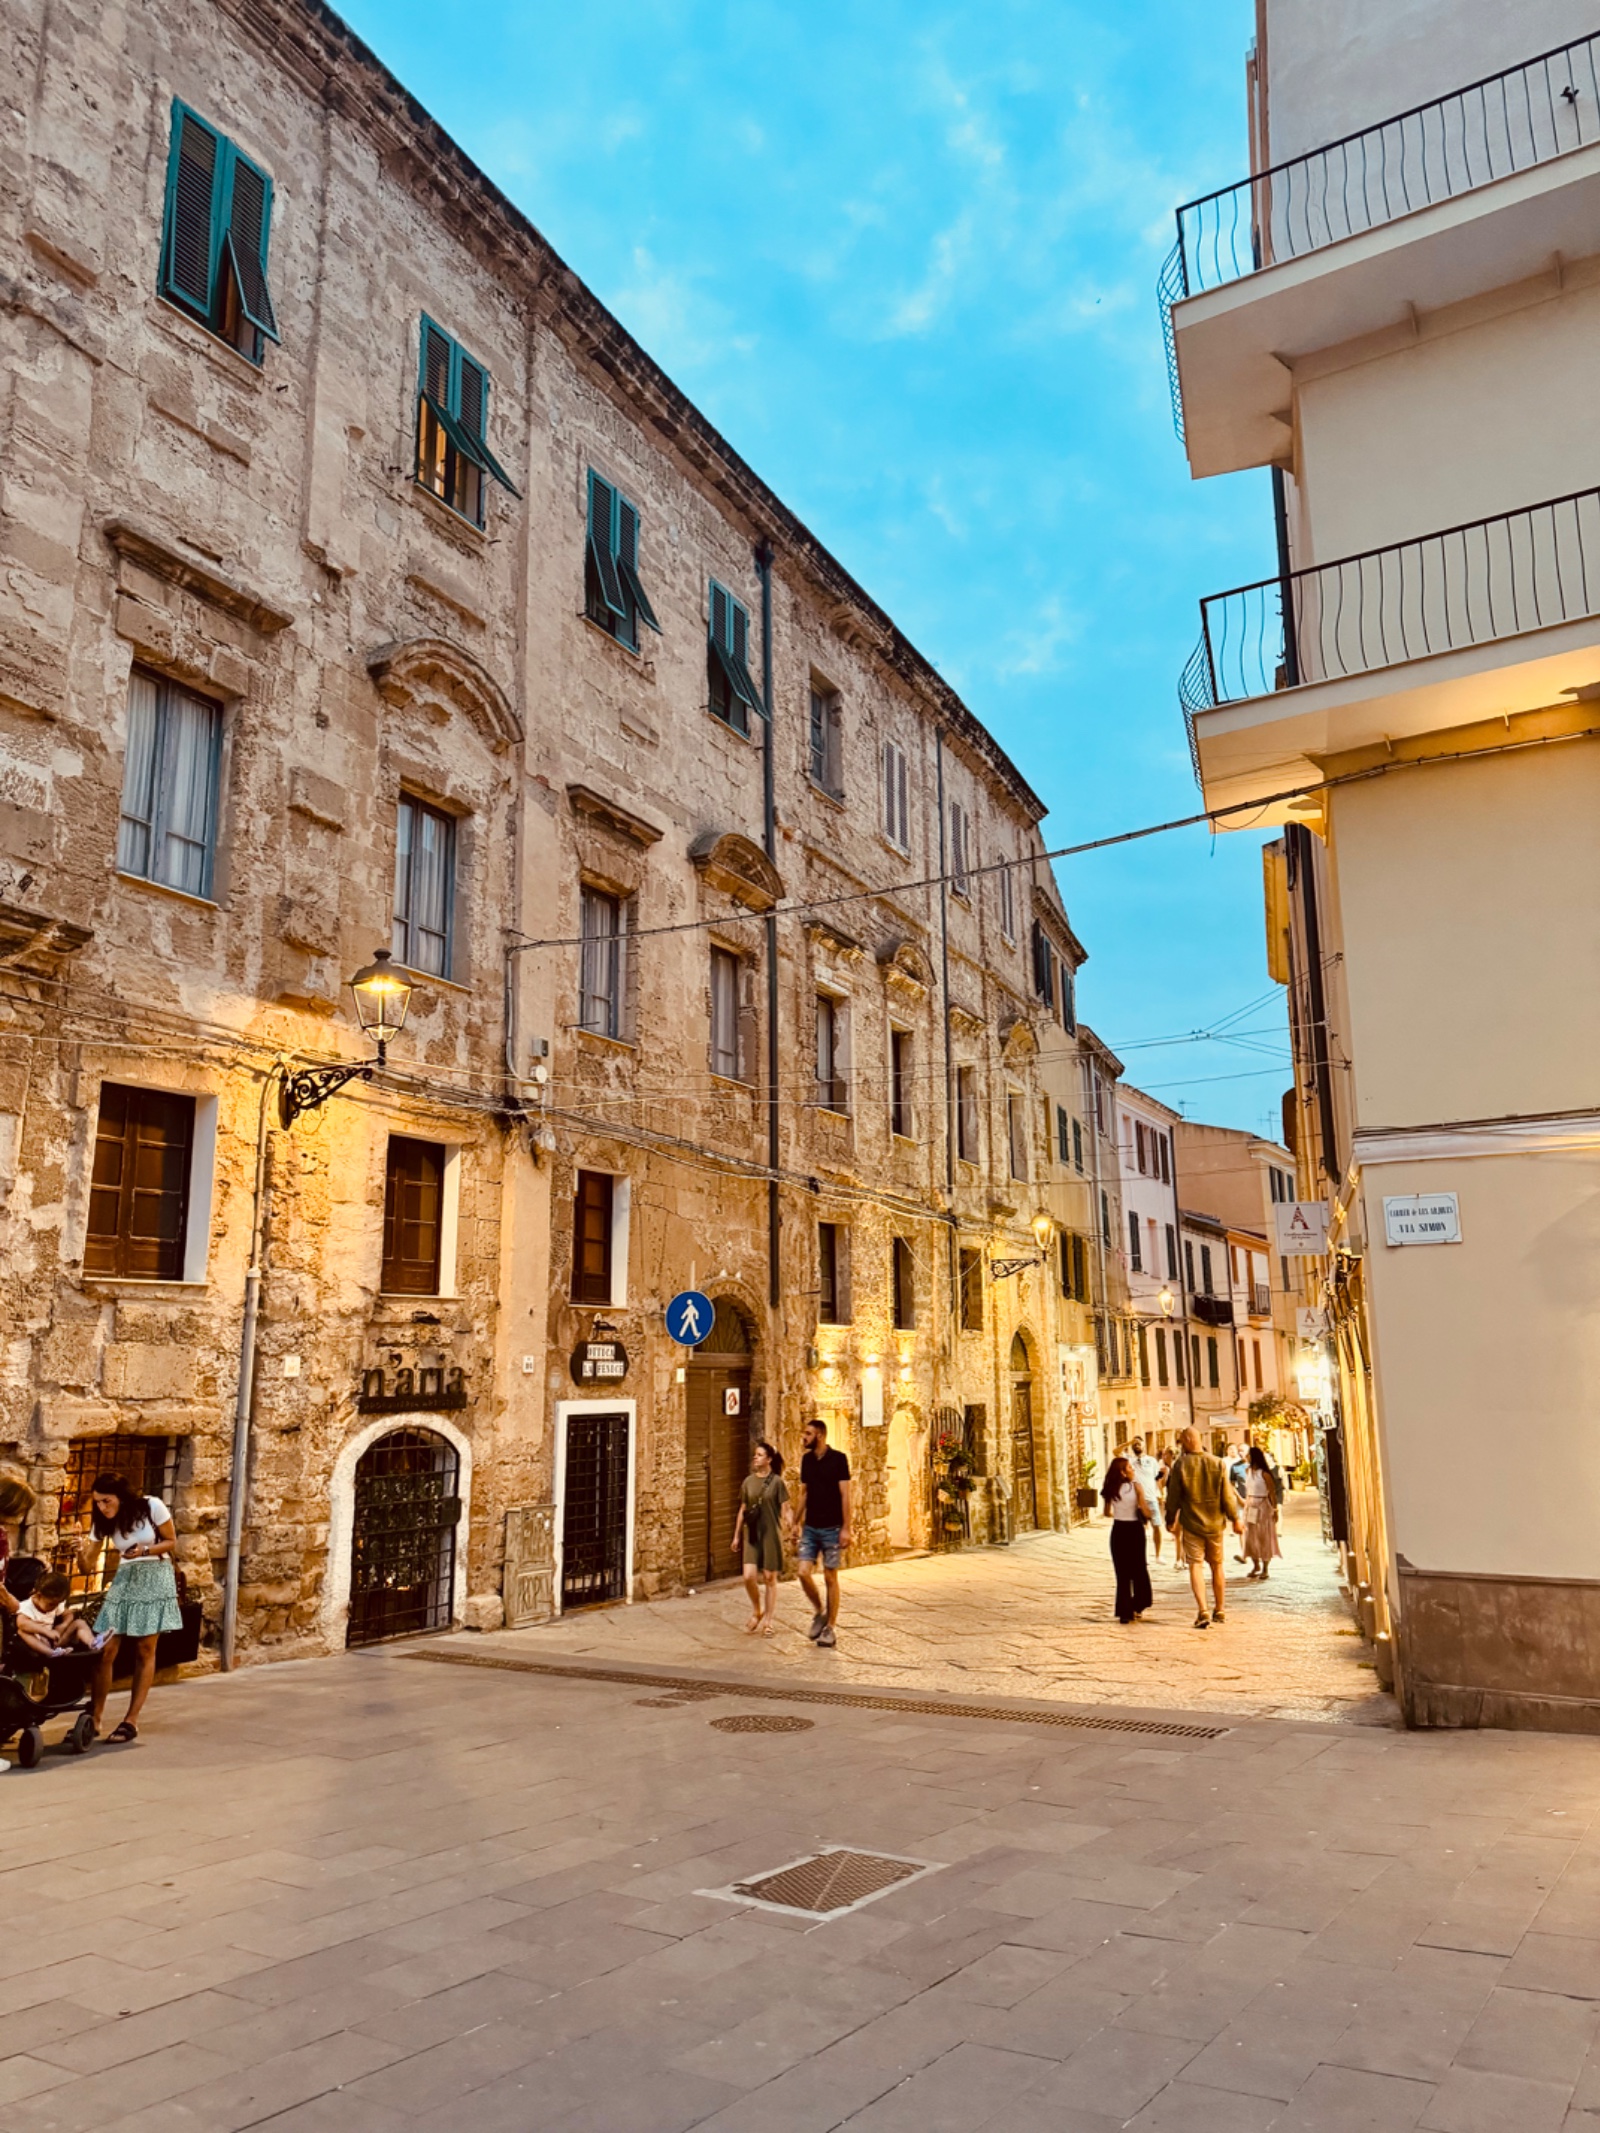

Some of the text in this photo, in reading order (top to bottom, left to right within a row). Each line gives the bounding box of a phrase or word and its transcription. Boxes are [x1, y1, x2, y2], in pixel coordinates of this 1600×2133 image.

[1290, 1205, 1310, 1230] A
[1399, 1221, 1446, 1233] VIA SIMON
[597, 1364, 624, 1374] FENICE
